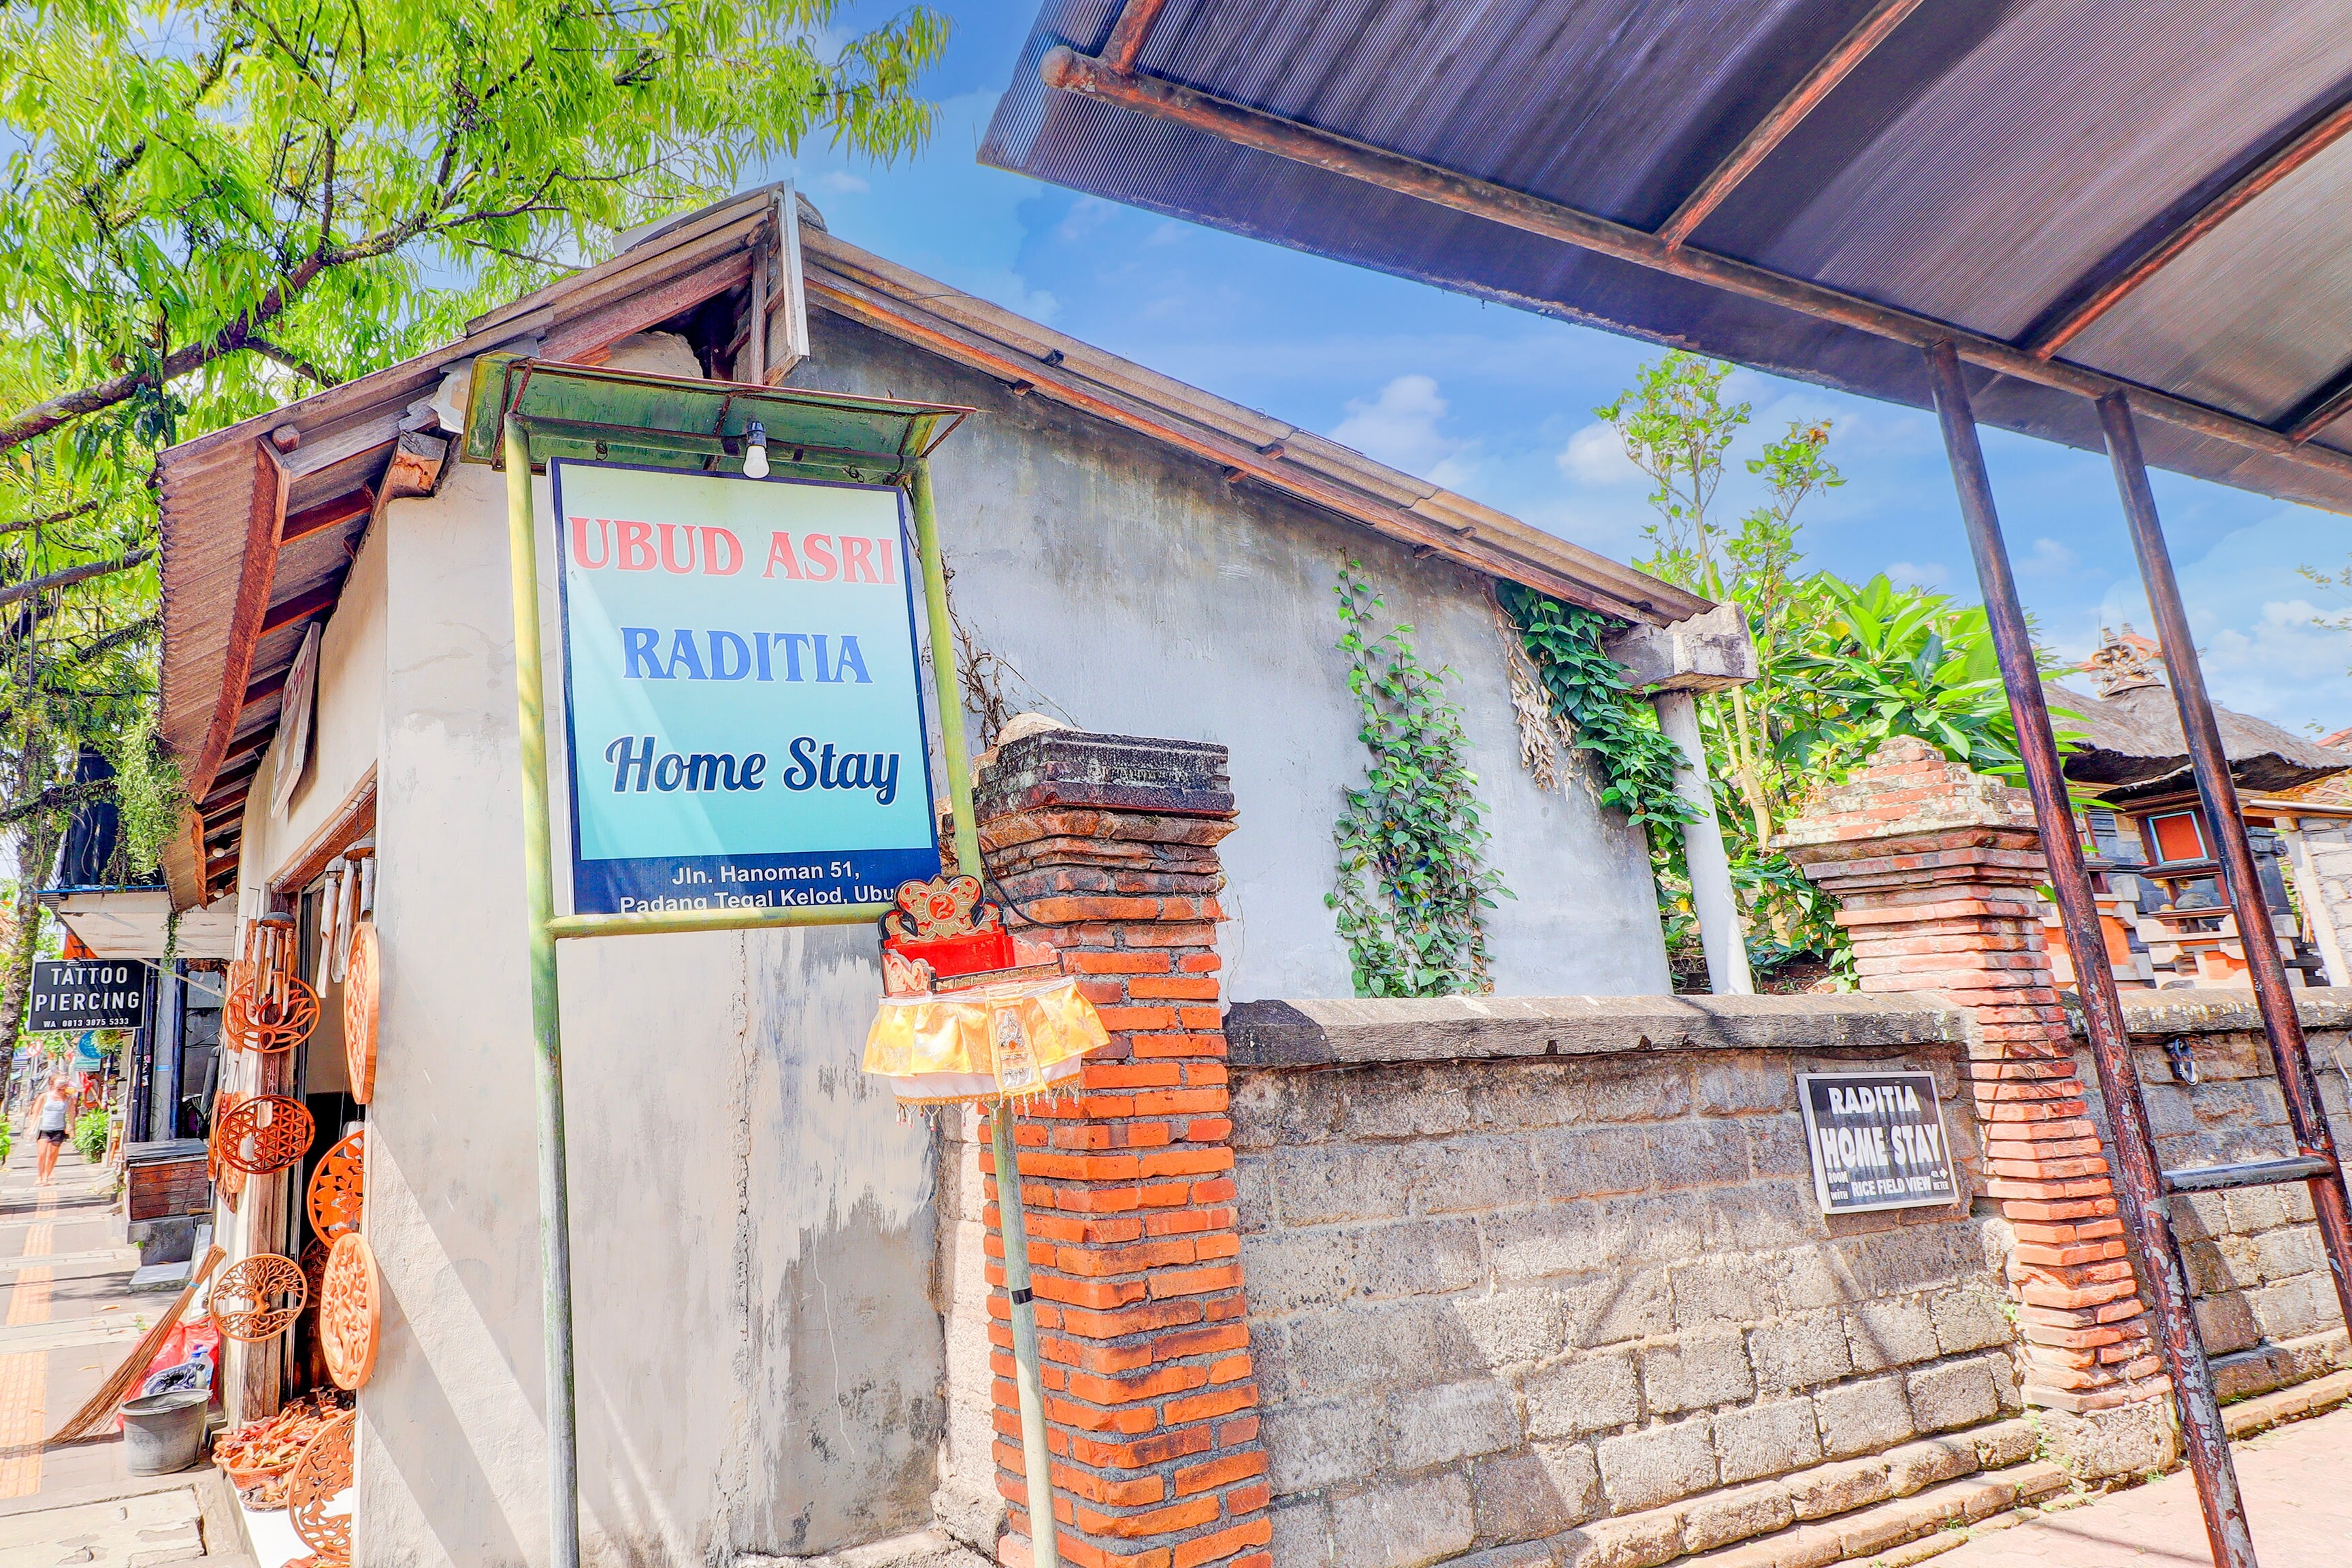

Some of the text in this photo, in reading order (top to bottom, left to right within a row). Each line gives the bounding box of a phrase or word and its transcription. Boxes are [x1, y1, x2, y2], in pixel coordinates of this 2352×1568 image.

[568, 517, 898, 585] UBUD ASRI
[620, 627, 873, 685] RADITIA
[604, 734, 900, 807] Home Stay
[672, 860, 860, 885] Jln. Hanoman 51,
[620, 884, 896, 914] Padang Tegal Kelod, Ubu
[50, 966, 128, 986] TATTOO
[35, 991, 140, 1013] PIERCING
[43, 1019, 56, 1028] WA
[62, 1019, 82, 1027] 0813
[109, 1017, 129, 1026] 5333
[1827, 1085, 1921, 1114] RADITIA
[1818, 1124, 1941, 1169] HOME STAY
[1827, 1171, 1849, 1184] ROOM
[1850, 1175, 1933, 1197] RICE FIELD VIEW
[1932, 1181, 1950, 1191] METER
